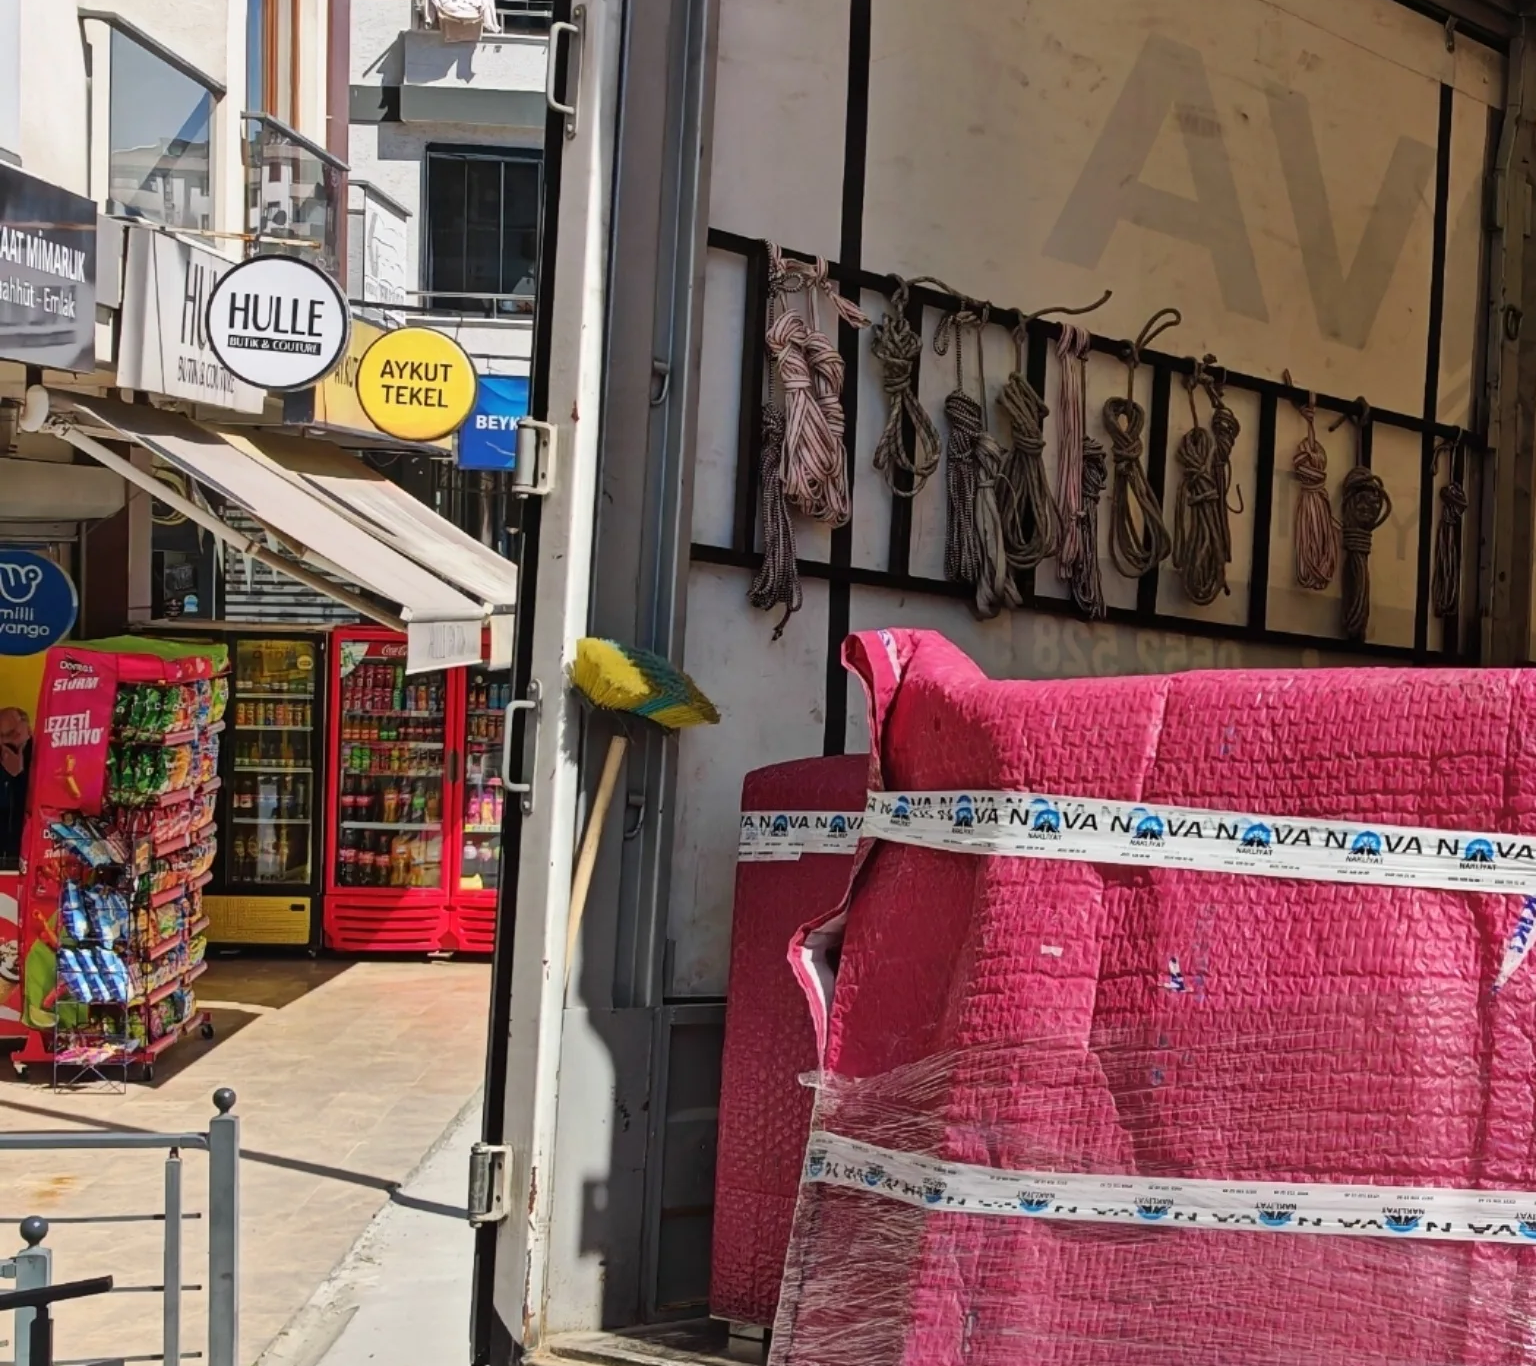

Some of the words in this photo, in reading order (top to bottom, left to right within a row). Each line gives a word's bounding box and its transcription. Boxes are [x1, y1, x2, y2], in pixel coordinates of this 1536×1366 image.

[229, 292, 325, 337] HULLE
[380, 359, 453, 382] AYKUT
[381, 384, 449, 408] TEKEL
[1009, 802, 1098, 833] NOVA
[1109, 812, 1203, 841] NOVA
[1215, 821, 1311, 848] NOVA
[1324, 829, 1422, 856] NOVA
[1437, 838, 1534, 864] NOVA
